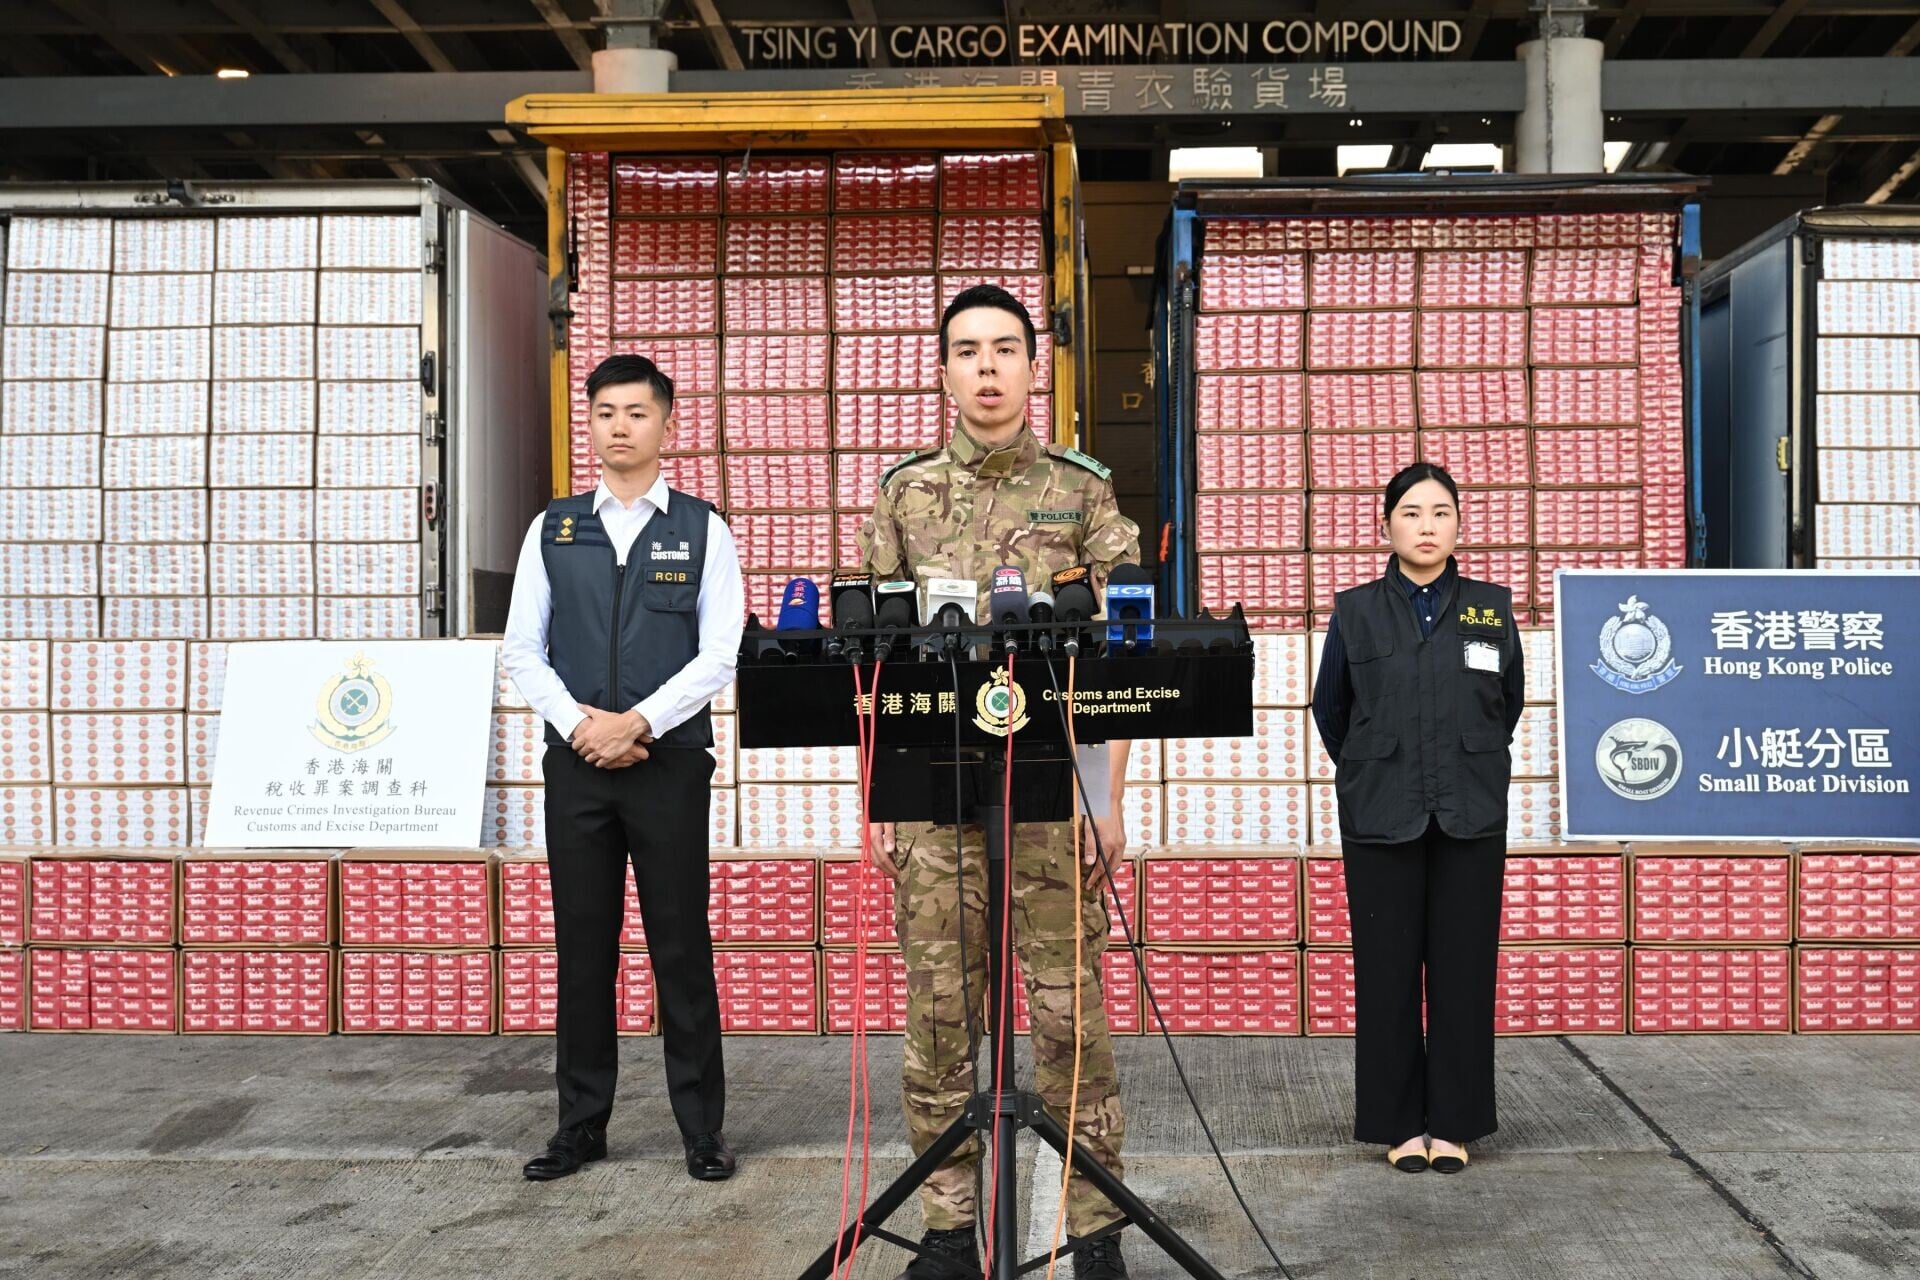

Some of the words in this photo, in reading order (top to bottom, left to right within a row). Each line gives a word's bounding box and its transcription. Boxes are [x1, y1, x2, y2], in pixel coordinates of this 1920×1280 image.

[741, 27, 838, 60] TSING
[848, 27, 877, 59] YI
[890, 25, 1007, 58] CARGO
[1019, 22, 1249, 57] EXAMINATION
[1262, 20, 1462, 54] COMPOUND
[1041, 512, 1075, 521] POLICE
[651, 551, 690, 560] CUSTOMS
[655, 572, 687, 582] RCIB
[1460, 614, 1502, 626] POLICE
[1711, 610, 1885, 651] 香港警察
[1704, 657, 1762, 680] Hong
[1767, 657, 1825, 680] Kong
[1830, 657, 1893, 676] Police
[1106, 688, 1132, 699] and
[1135, 687, 1180, 699] Excise
[1073, 701, 1152, 716] Department
[1716, 727, 1893, 768] 小艇分區
[305, 757, 393, 775] 香港海關
[1631, 757, 1660, 771] SBDIV
[1699, 774, 1760, 793] Small
[1766, 775, 1816, 793] Boat
[1822, 775, 1910, 793] Division
[234, 804, 283, 816] Revenue
[287, 804, 329, 815] Crimes
[333, 803, 410, 818] Investigation
[414, 804, 457, 816] Bureau
[247, 820, 297, 832] Customs
[300, 820, 322, 832] and
[326, 820, 365, 832] Excise
[369, 820, 439, 834] Department
